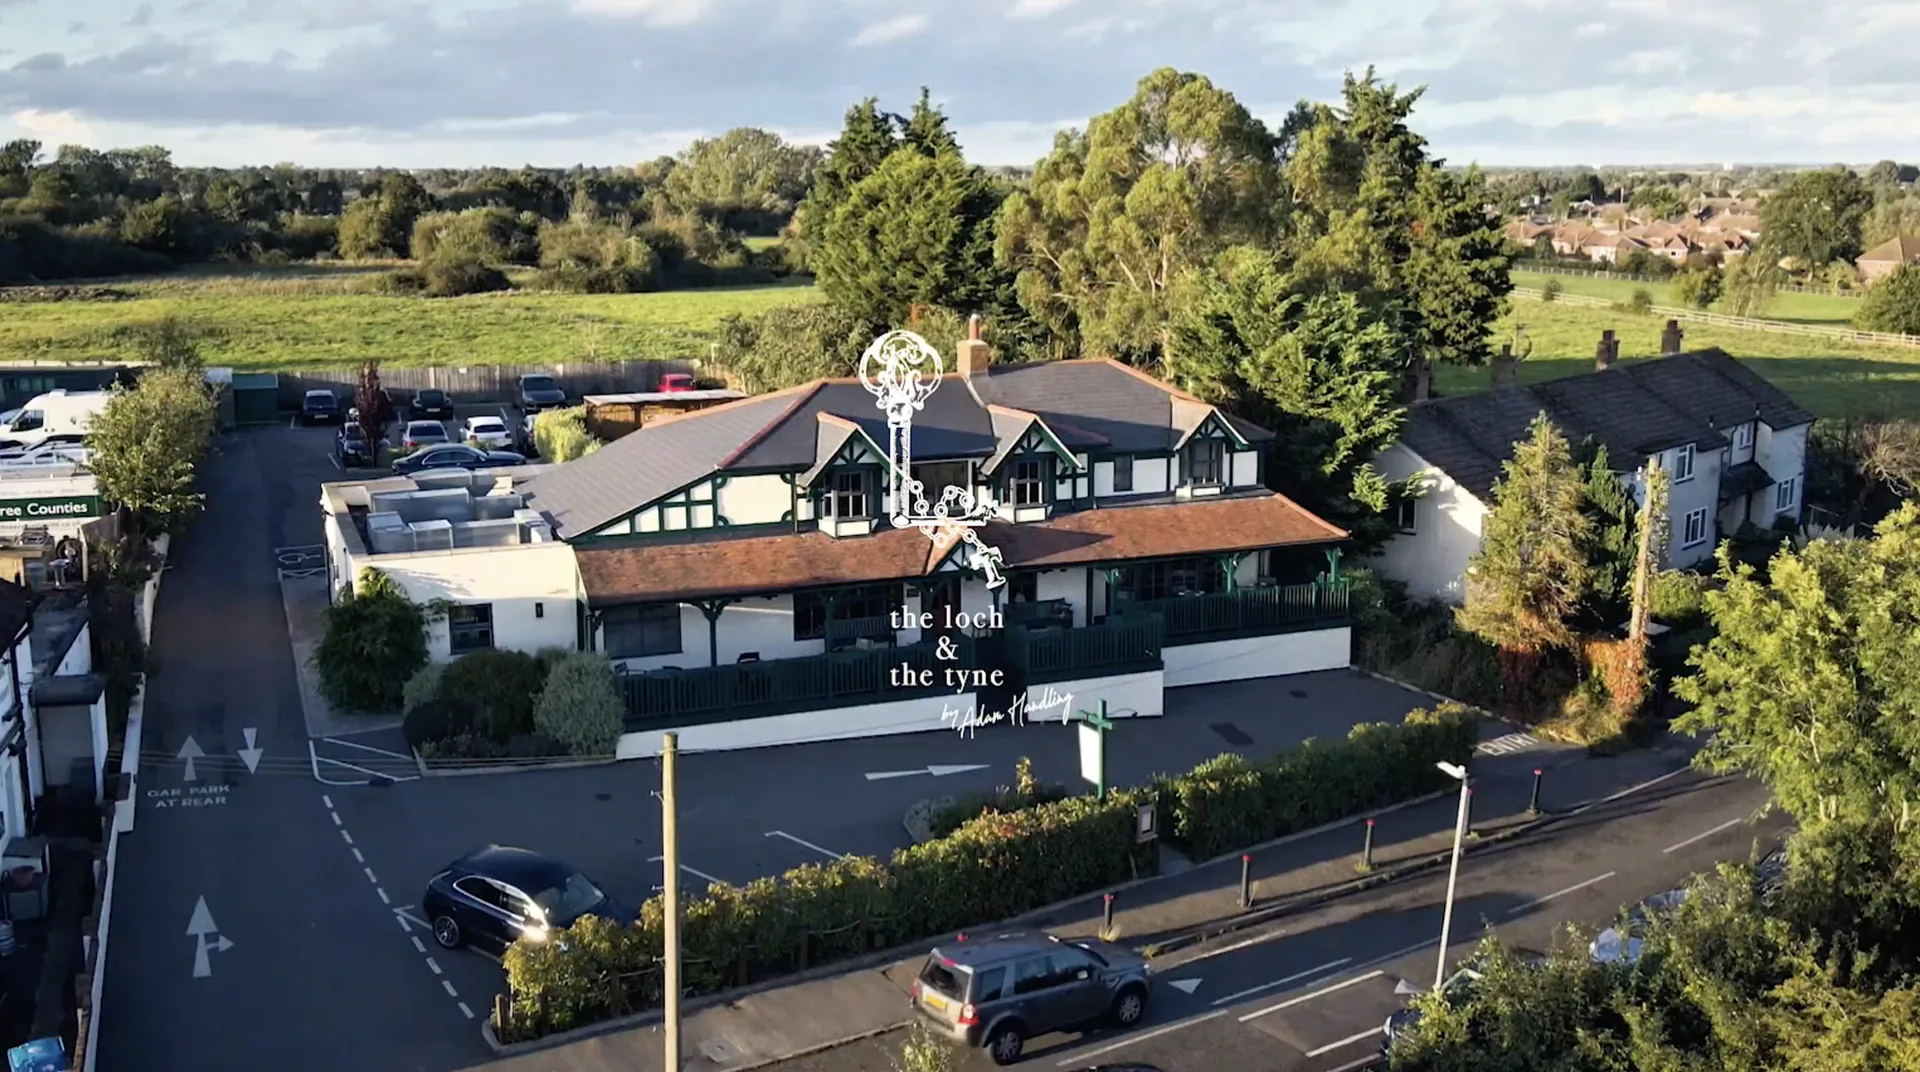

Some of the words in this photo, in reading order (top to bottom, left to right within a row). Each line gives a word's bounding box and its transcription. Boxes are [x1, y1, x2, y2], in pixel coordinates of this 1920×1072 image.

[27, 502, 88, 515] Counties
[147, 788, 181, 798] CAR
[190, 784, 230, 795] PARK
[156, 799, 178, 808] AT
[181, 796, 226, 807] REAR
